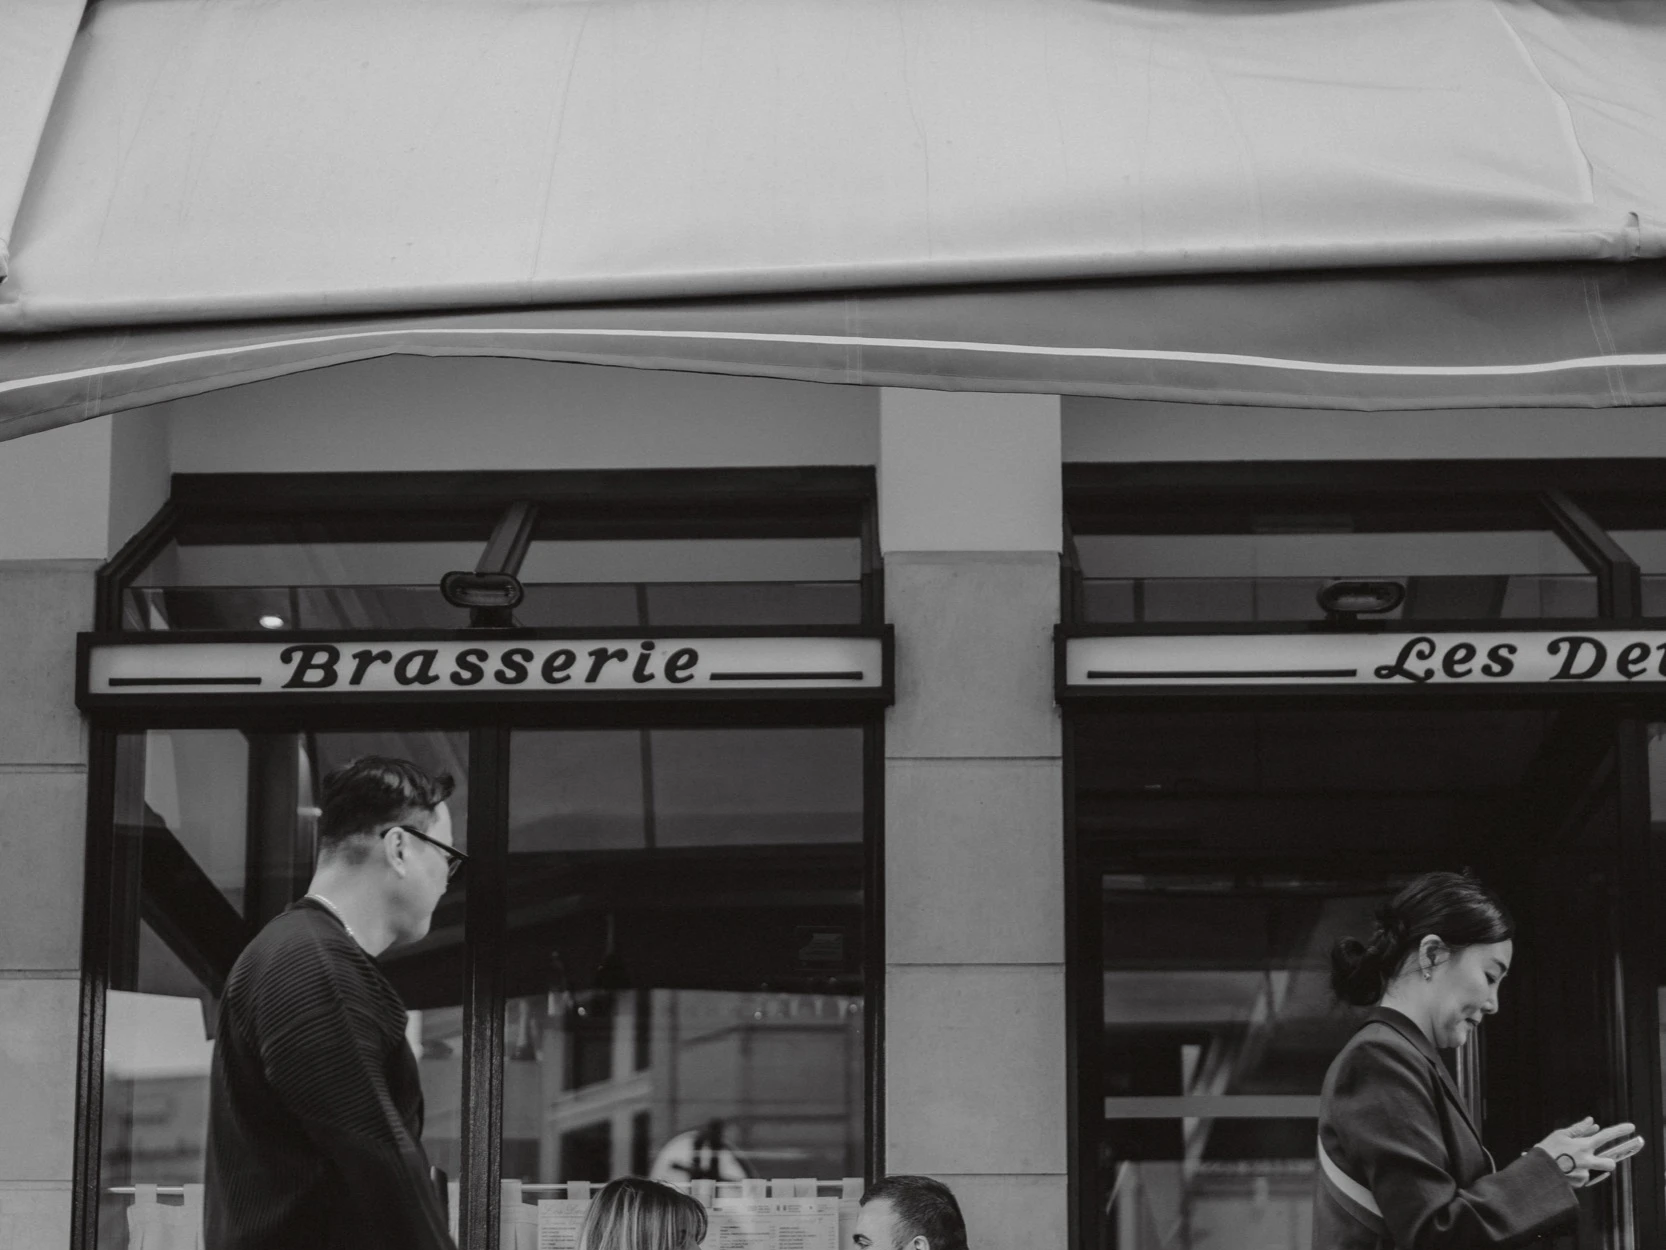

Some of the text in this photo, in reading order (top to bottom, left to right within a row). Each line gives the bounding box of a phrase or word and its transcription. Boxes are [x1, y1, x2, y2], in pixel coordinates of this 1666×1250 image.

[279, 641, 700, 689] Brasserie
[1373, 636, 1666, 682] Les De
